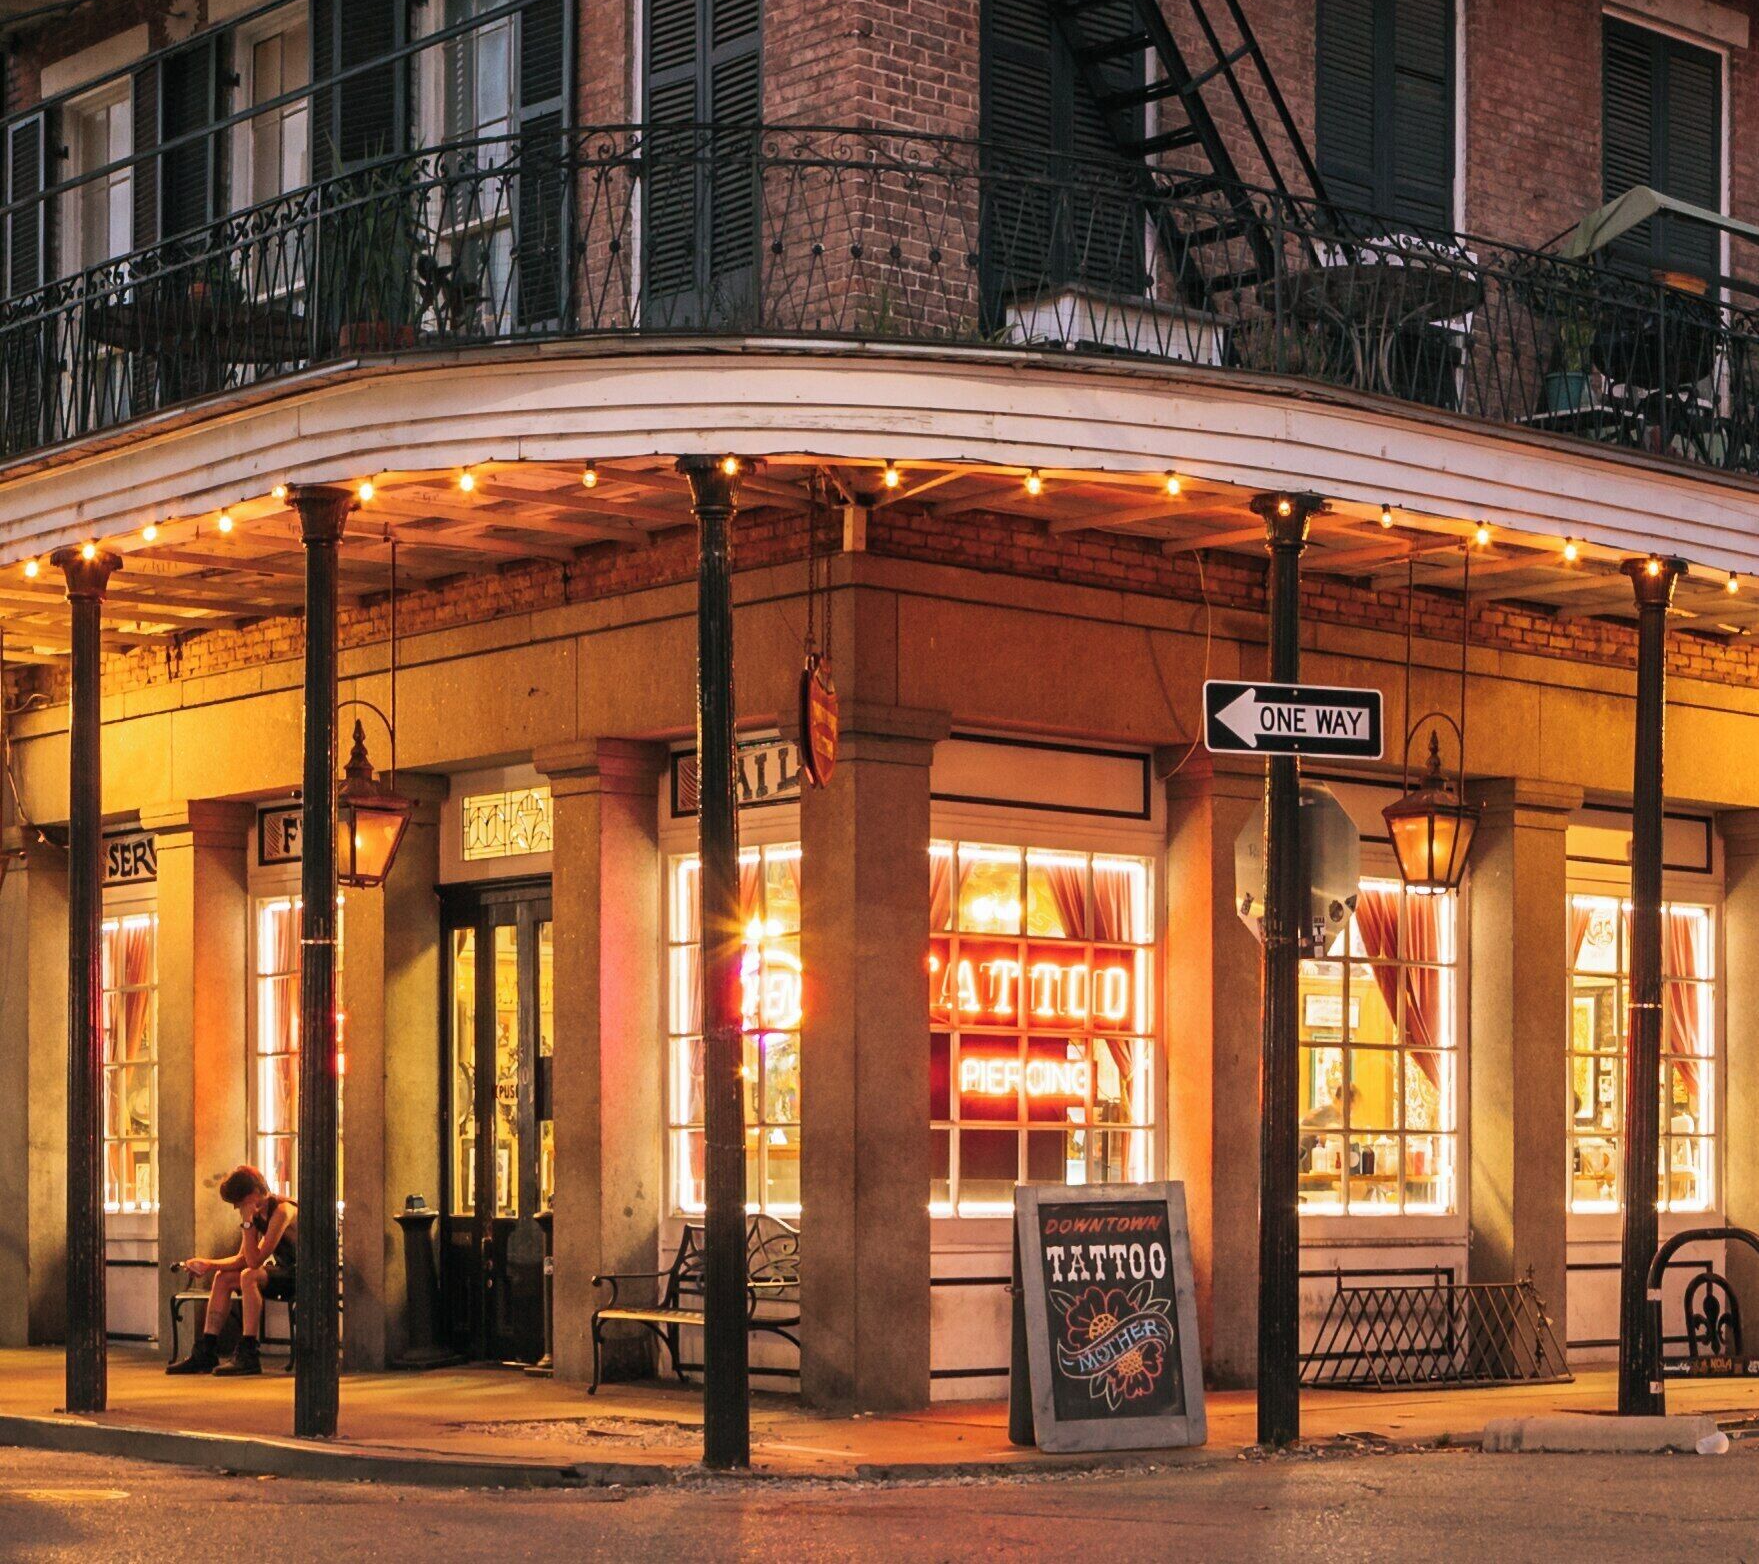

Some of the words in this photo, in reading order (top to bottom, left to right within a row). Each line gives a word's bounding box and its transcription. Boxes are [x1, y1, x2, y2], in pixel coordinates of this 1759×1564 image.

[1260, 706, 1306, 733] ONE
[1316, 709, 1362, 735] WAY
[929, 957, 1127, 1020] ATTOO
[961, 1057, 1089, 1096] PIERCING
[1045, 1215, 1163, 1234] DOWNTOWN
[1046, 1242, 1166, 1283] TATTOO
[1080, 1319, 1160, 1373] MOTHER
